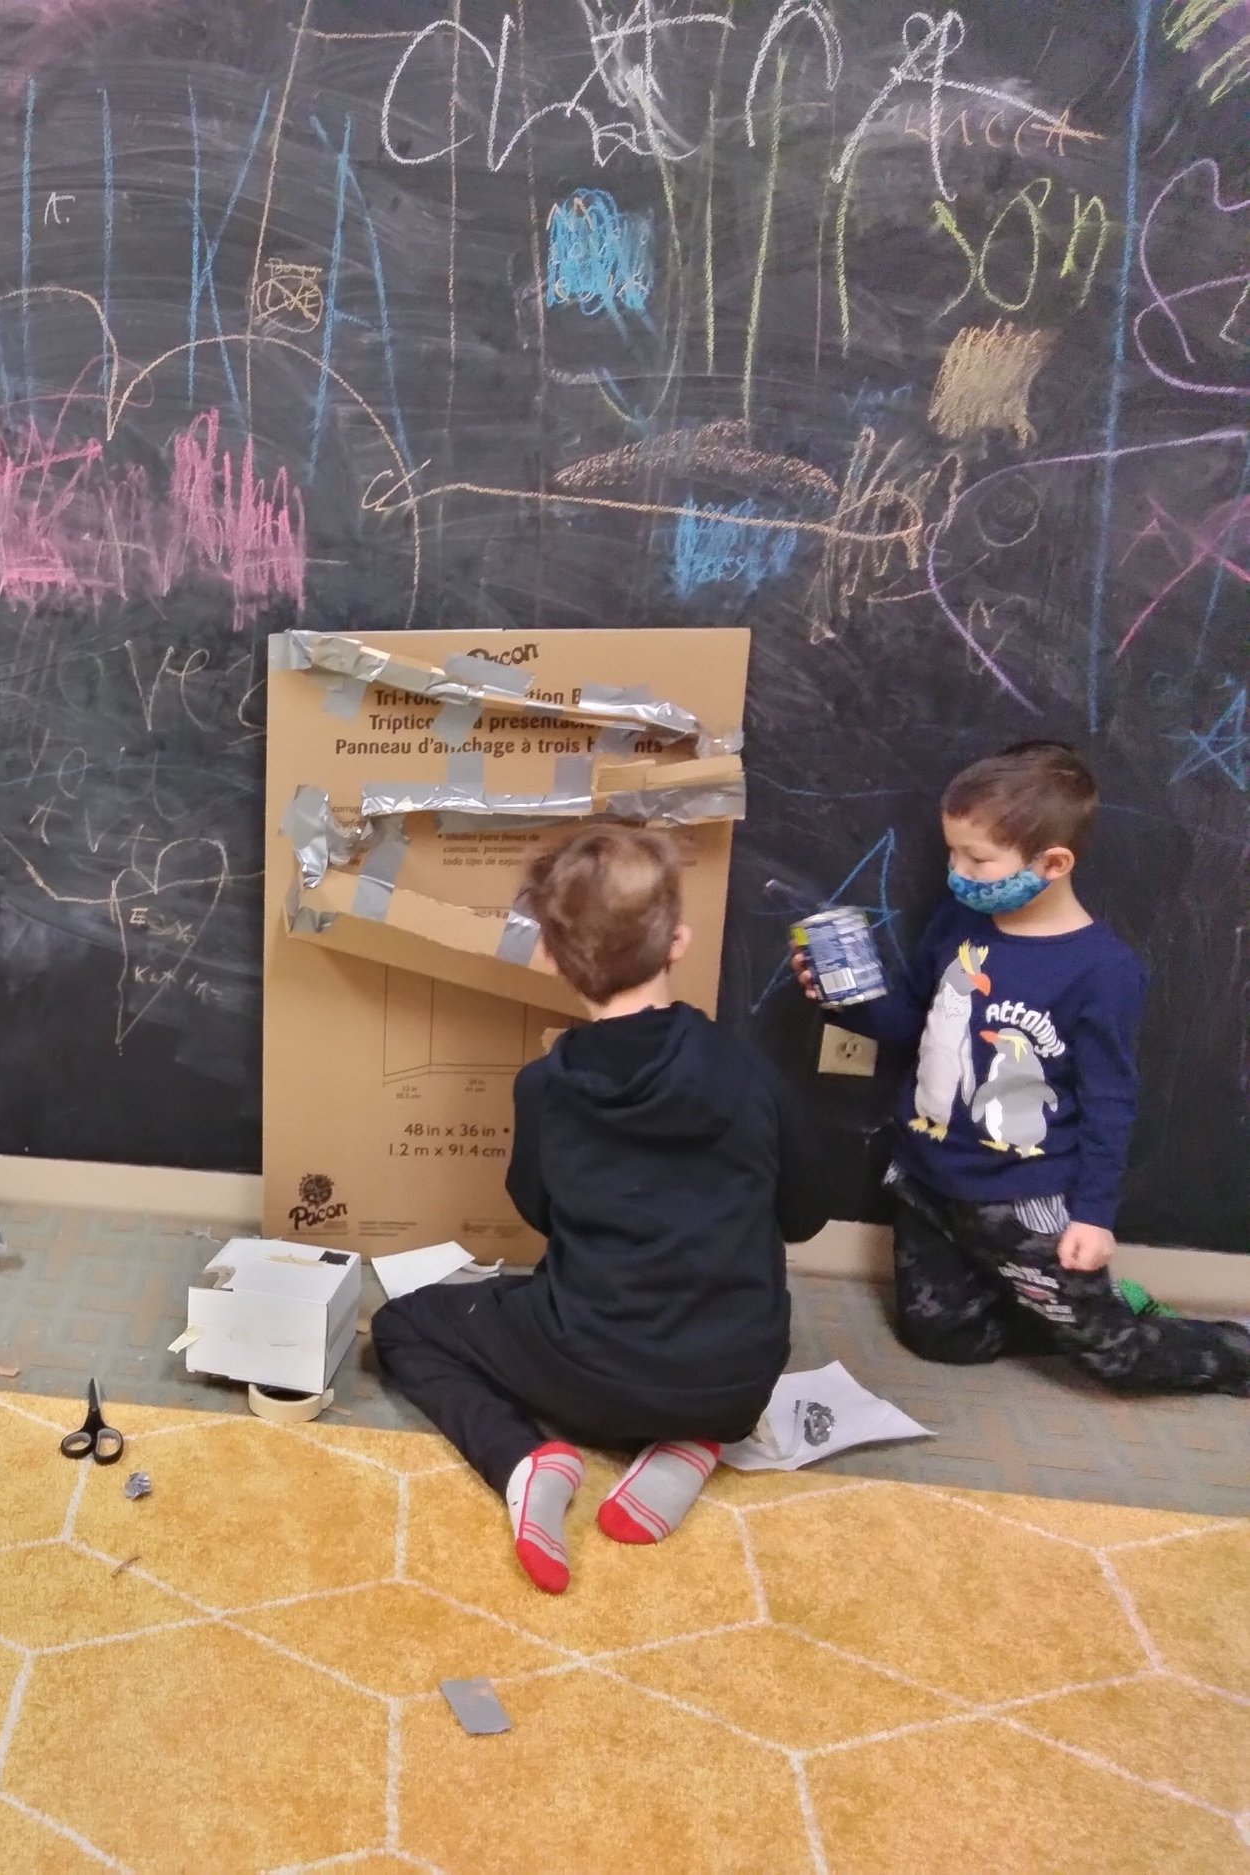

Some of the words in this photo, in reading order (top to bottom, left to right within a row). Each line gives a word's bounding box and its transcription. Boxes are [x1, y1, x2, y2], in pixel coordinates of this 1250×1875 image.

[335, 738, 412, 755] Panneau
[520, 737, 532, 753] à
[538, 737, 581, 753] trois
[389, 1143, 409, 1157] 1.2
[414, 1147, 429, 1157] m
[434, 1147, 444, 1156] x
[448, 1144, 478, 1157] 91.4
[482, 1146, 506, 1157] cm
[288, 1202, 348, 1230] Pacon
